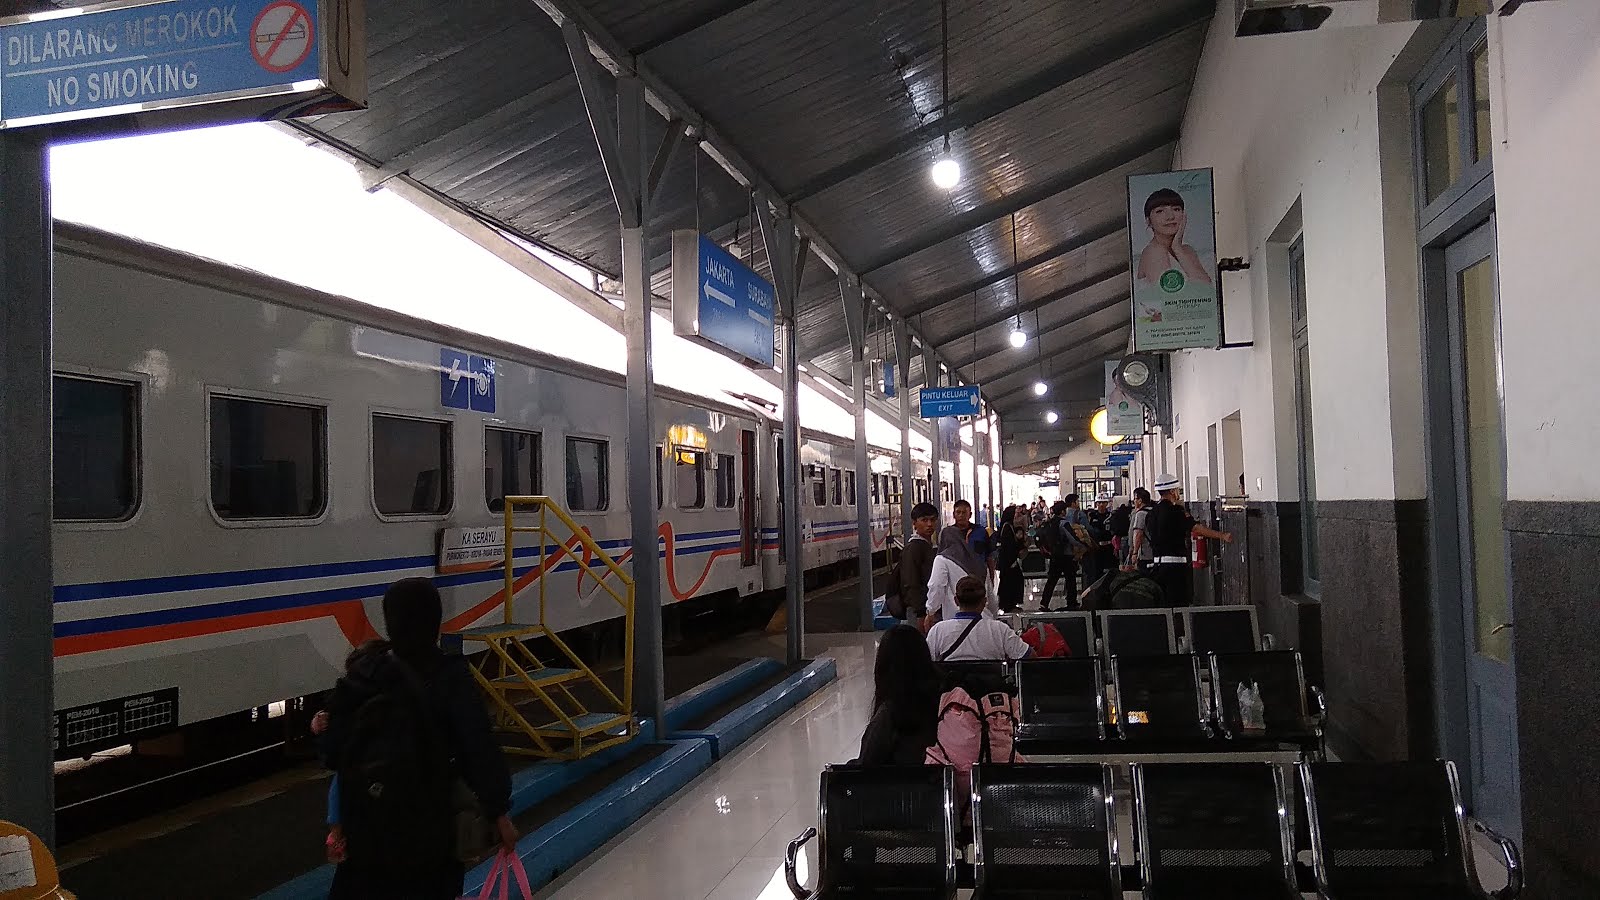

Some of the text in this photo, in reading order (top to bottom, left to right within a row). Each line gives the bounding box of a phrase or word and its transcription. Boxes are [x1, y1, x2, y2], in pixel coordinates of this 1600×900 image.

[7, 4, 239, 67] DILARANG MEROKOK
[47, 60, 199, 108] NO SMOKING
[705, 255, 736, 289] JAKARTA
[921, 390, 969, 400] PINTU KELUAR
[938, 404, 953, 412] EXIT
[462, 531, 496, 545] KA SERAYU
